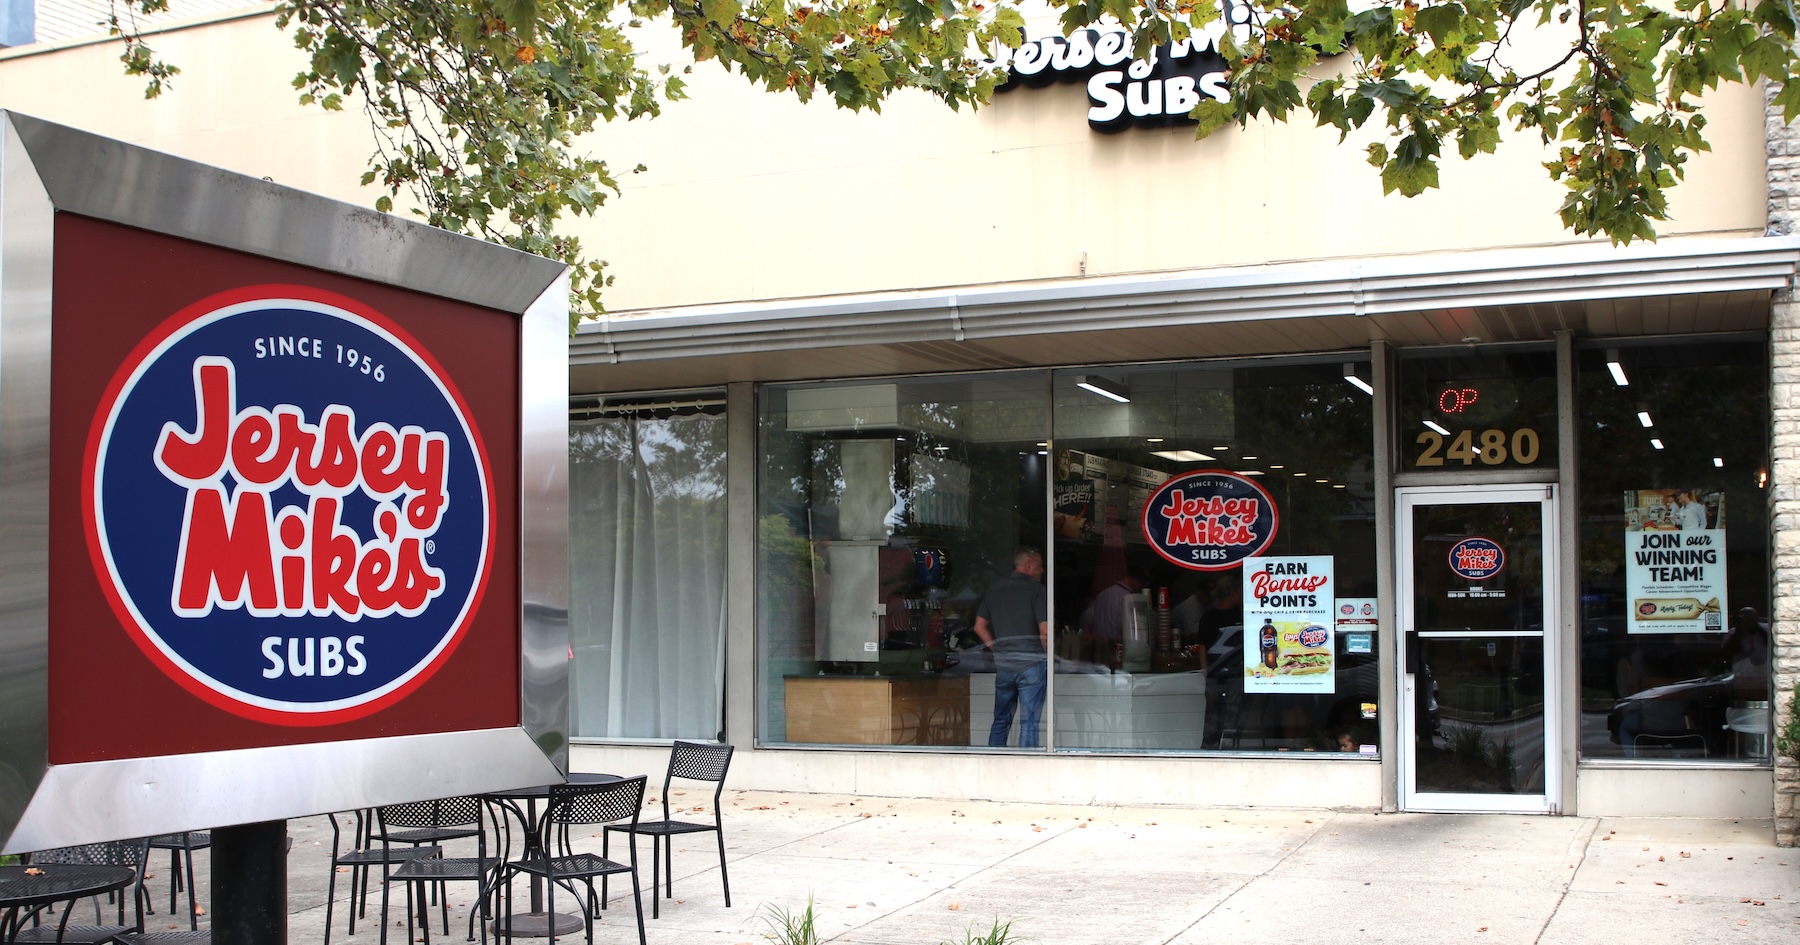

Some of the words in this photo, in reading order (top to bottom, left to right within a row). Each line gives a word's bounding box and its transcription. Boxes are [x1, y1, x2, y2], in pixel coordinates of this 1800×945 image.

[254, 336, 323, 359] SINCE
[336, 344, 387, 383] 1956
[153, 355, 449, 537] Jersey
[1415, 428, 1540, 467] 2480
[1074, 483, 1091, 492] Order
[1188, 480, 1211, 489] SINCE
[1215, 481, 1234, 489] 1956
[1161, 489, 1258, 524] Jersey
[1166, 516, 1257, 546] Mike's
[1641, 533, 1680, 549] JOIN
[1686, 535, 1712, 546] our
[171, 486, 446, 622] Mike's
[1191, 549, 1227, 560] SUBS
[1456, 545, 1497, 561] Jersey
[1635, 549, 1717, 566] WINNING
[1266, 563, 1307, 575] EARN
[1649, 566, 1704, 582] TEAM!
[1251, 571, 1327, 598] Bonus
[1260, 595, 1317, 608] POINTS
[1660, 605, 1676, 613] Apply
[261, 635, 367, 679] SUBS
